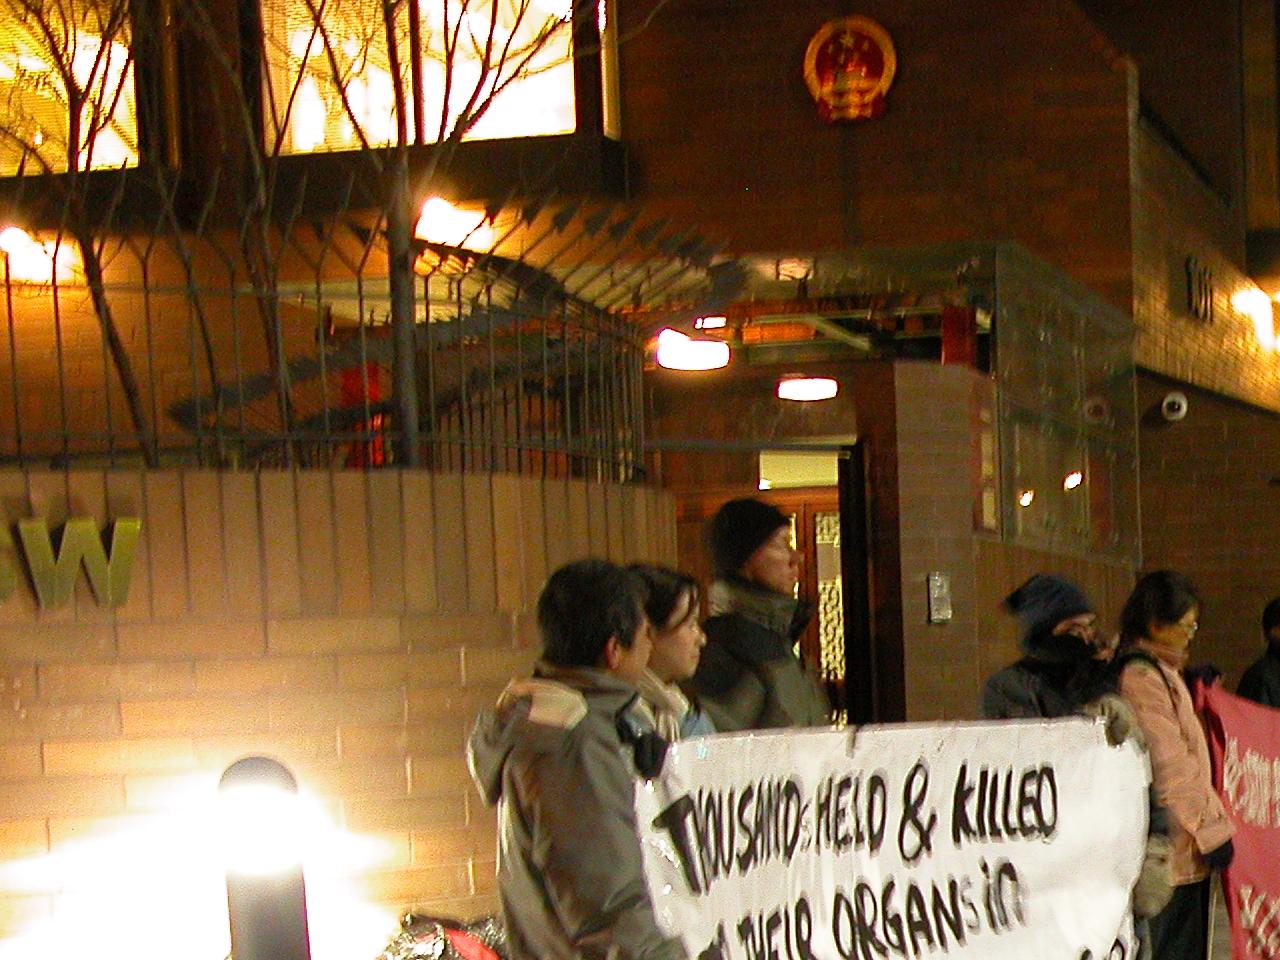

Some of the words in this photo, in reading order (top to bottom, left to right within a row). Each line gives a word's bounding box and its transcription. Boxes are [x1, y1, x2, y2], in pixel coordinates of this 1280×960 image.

[0, 517, 142, 612] W
[815, 768, 888, 857] HELD
[899, 757, 937, 865] &
[951, 759, 1059, 848] KILLED
